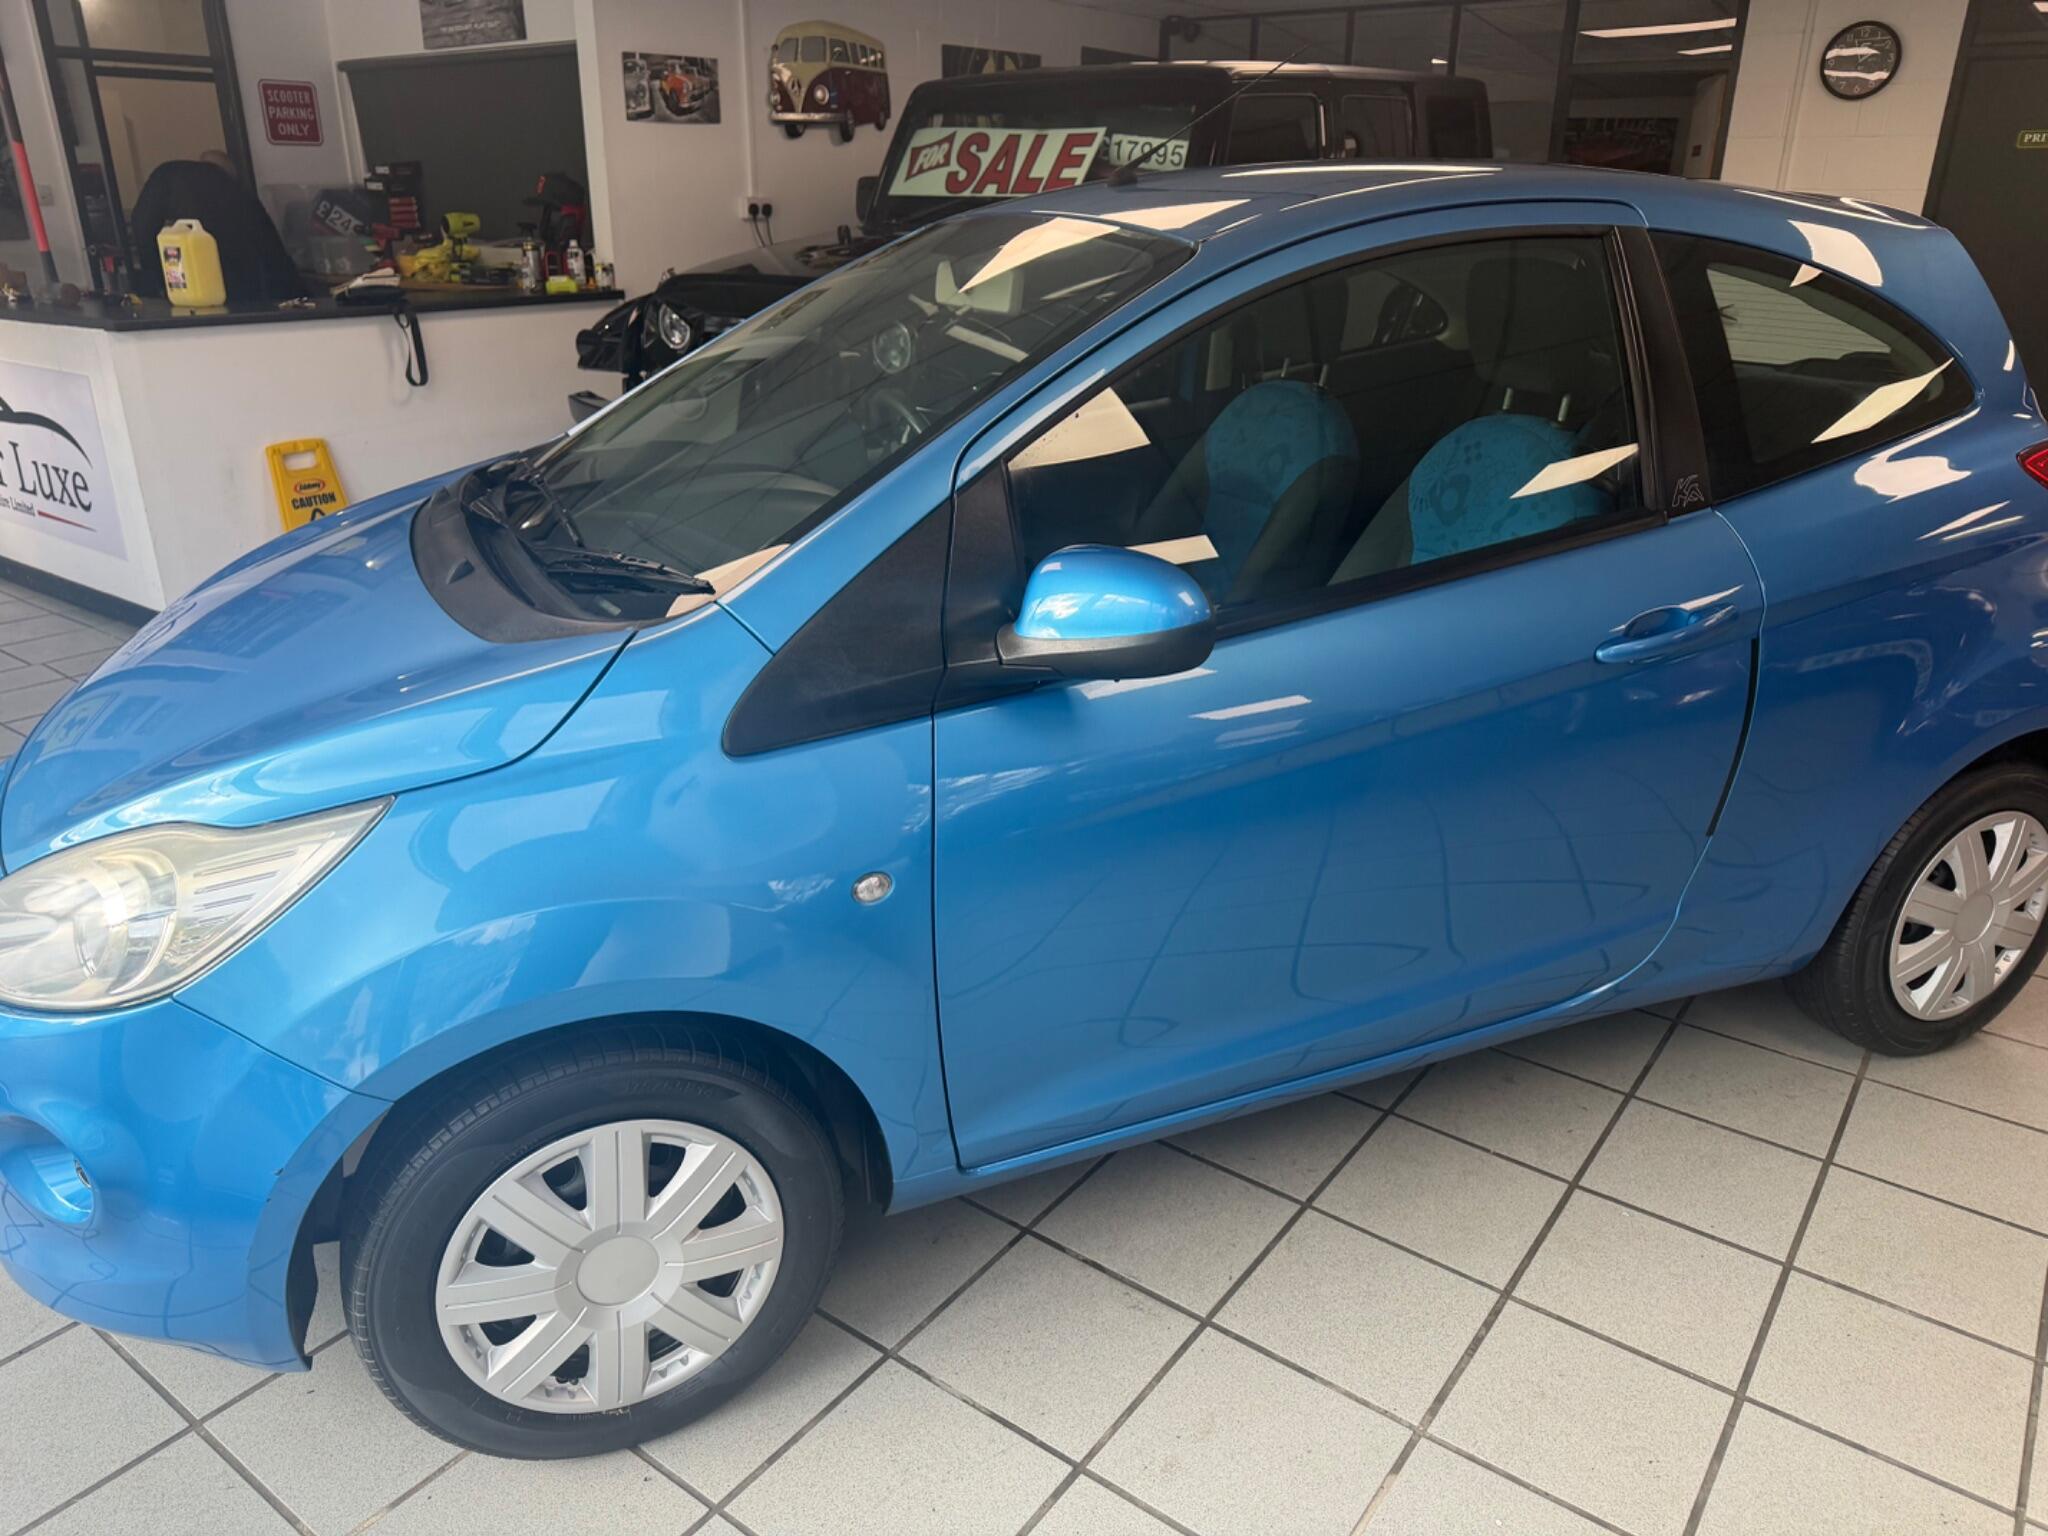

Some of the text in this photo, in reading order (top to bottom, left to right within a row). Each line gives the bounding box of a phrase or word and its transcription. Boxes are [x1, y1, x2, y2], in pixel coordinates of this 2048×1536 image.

[267, 90, 311, 104] SCOOTER
[268, 106, 315, 121] PARKING
[278, 123, 310, 136] ONLY
[2023, 132, 2048, 143] PRI
[911, 131, 1098, 195] FOR SALE
[8, 440, 92, 512] Luxe
[291, 491, 337, 511] CAUTION
